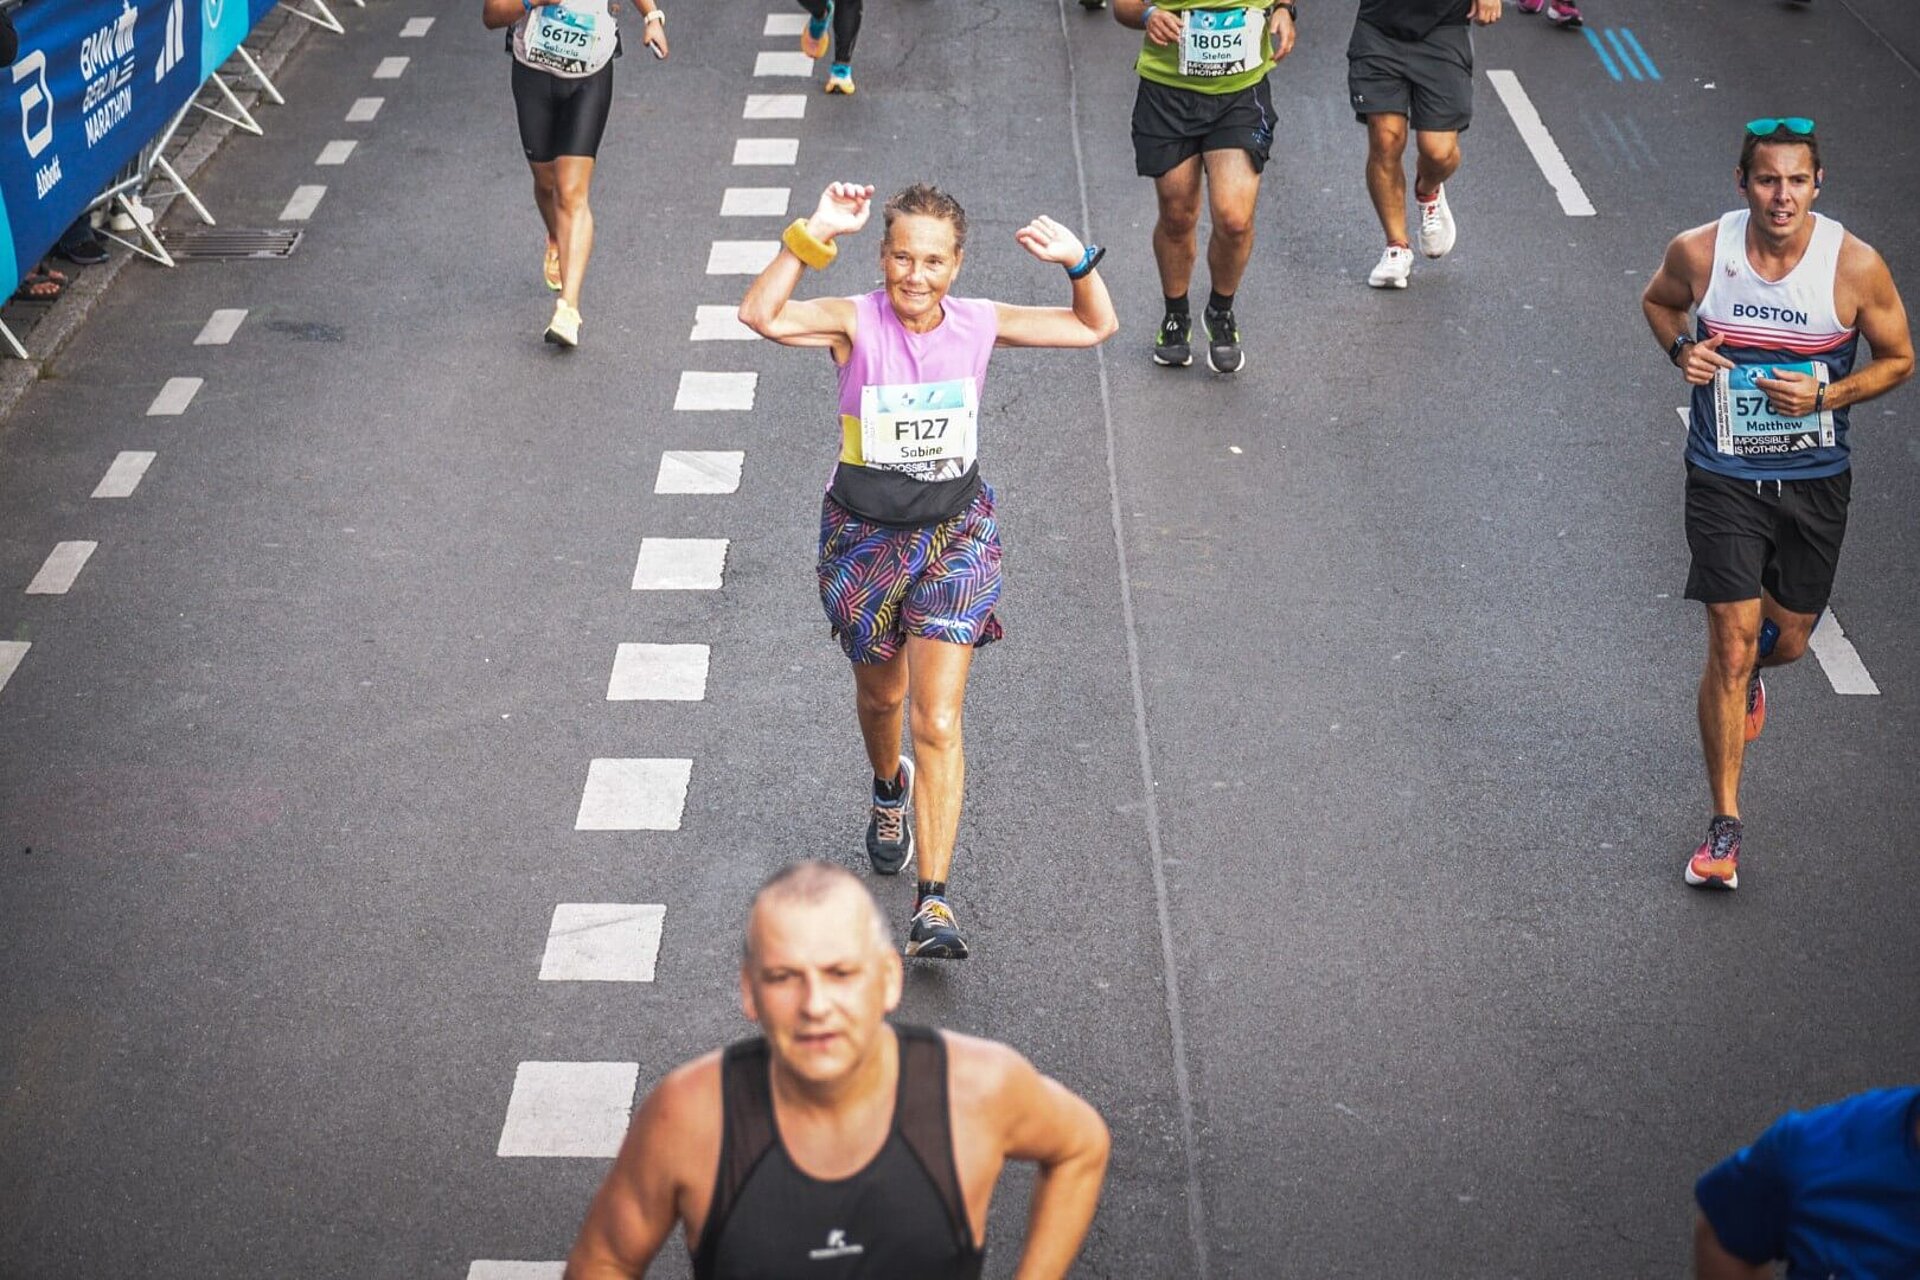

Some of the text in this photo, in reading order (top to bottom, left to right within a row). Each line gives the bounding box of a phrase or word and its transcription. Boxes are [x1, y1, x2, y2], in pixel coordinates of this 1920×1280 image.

[542, 25, 589, 47] 66175
[1191, 33, 1242, 49] 18054
[80, 22, 115, 81] BMW
[1202, 51, 1232, 60] Stefan
[82, 65, 119, 113] BERLIN
[84, 85, 132, 149] MARATHON
[36, 155, 63, 200] Abbott
[1733, 304, 1808, 325] BOSTON
[895, 418, 949, 440] F127
[1747, 420, 1803, 432] Matthew
[1734, 435, 1791, 445] IMPOSSIBLE
[1734, 445, 1788, 454] IS NOTHING
[900, 445, 943, 458] Sabine
